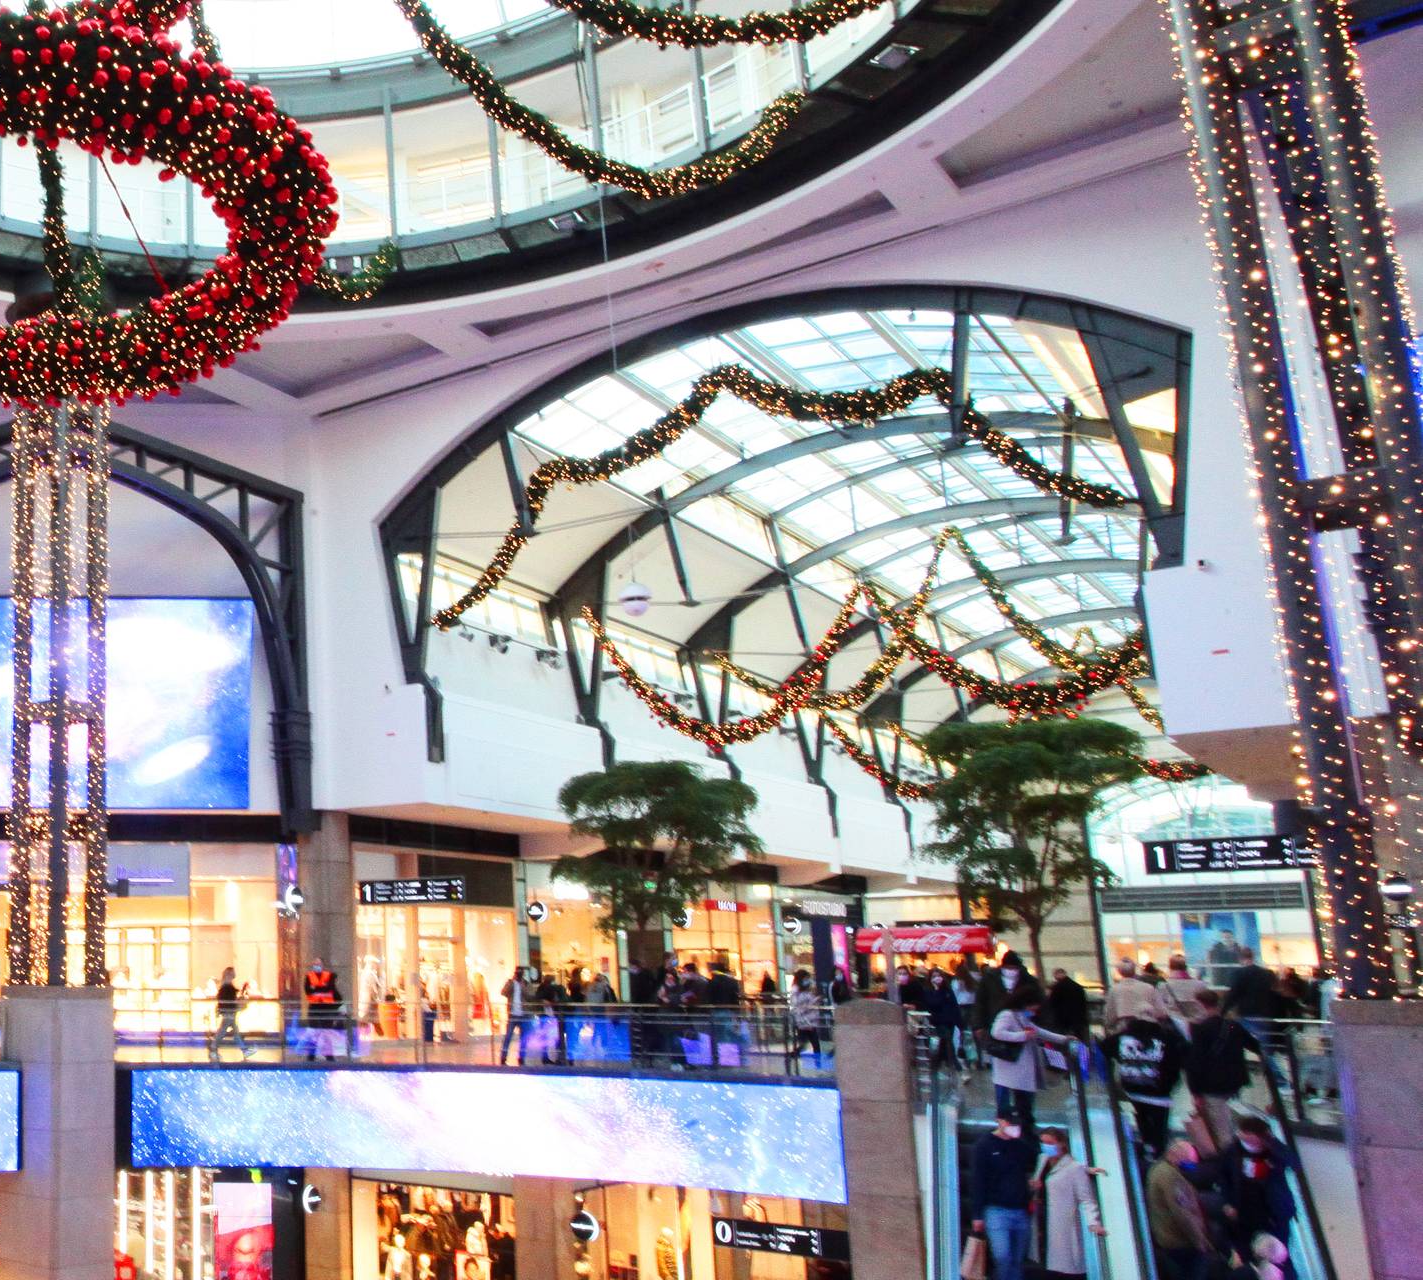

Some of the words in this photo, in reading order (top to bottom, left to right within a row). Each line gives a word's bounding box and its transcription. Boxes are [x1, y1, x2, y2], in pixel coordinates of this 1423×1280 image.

[1154, 846, 1167, 869] 1
[362, 884, 372, 902] 1
[715, 1220, 732, 1243] 0
